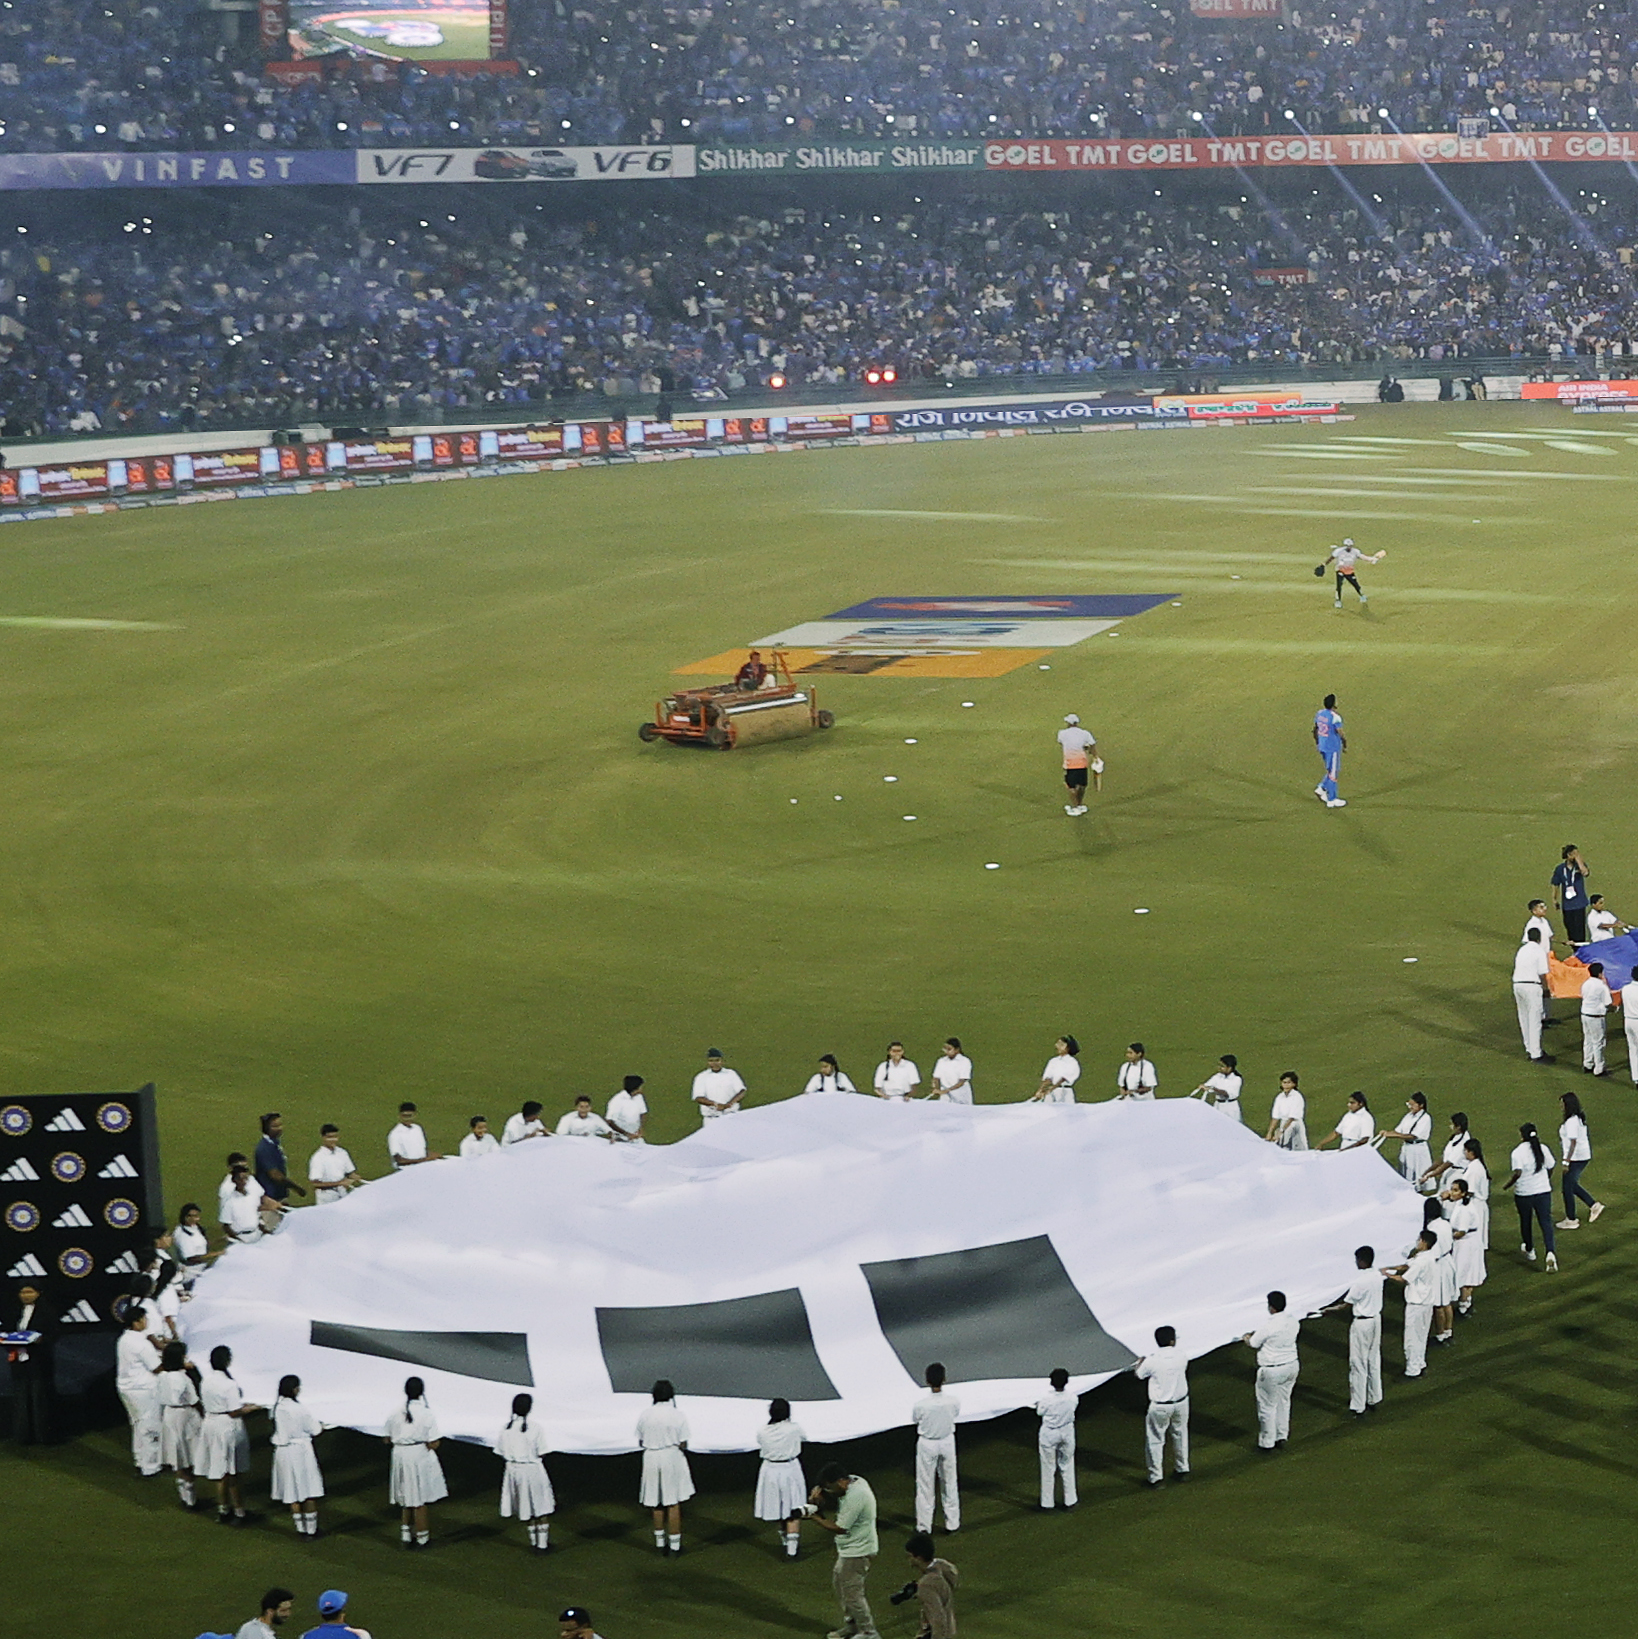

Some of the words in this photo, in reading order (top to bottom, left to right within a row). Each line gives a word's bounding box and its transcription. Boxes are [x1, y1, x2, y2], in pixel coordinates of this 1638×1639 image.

[264, 9, 283, 37] CP
[890, 145, 981, 167] Shikhar
[985, 144, 1056, 166] GOEL
[1065, 145, 1121, 164] TMT
[1127, 143, 1198, 164] GOEL
[1207, 142, 1262, 162] TMT
[1264, 141, 1337, 162] GOEL
[1350, 140, 1402, 160] TMT
[1417, 138, 1489, 159] GOEL
[1498, 136, 1553, 157] TMT
[1565, 136, 1636, 157] GOEL
[103, 157, 294, 181] VINFAST
[373, 154, 455, 177] VF7
[592, 151, 671, 174] VF6
[699, 148, 788, 171] Shikhar
[795, 147, 886, 169] Shikhar
[1558, 384, 1577, 393] AIR
[1579, 383, 1609, 393] INDIA
